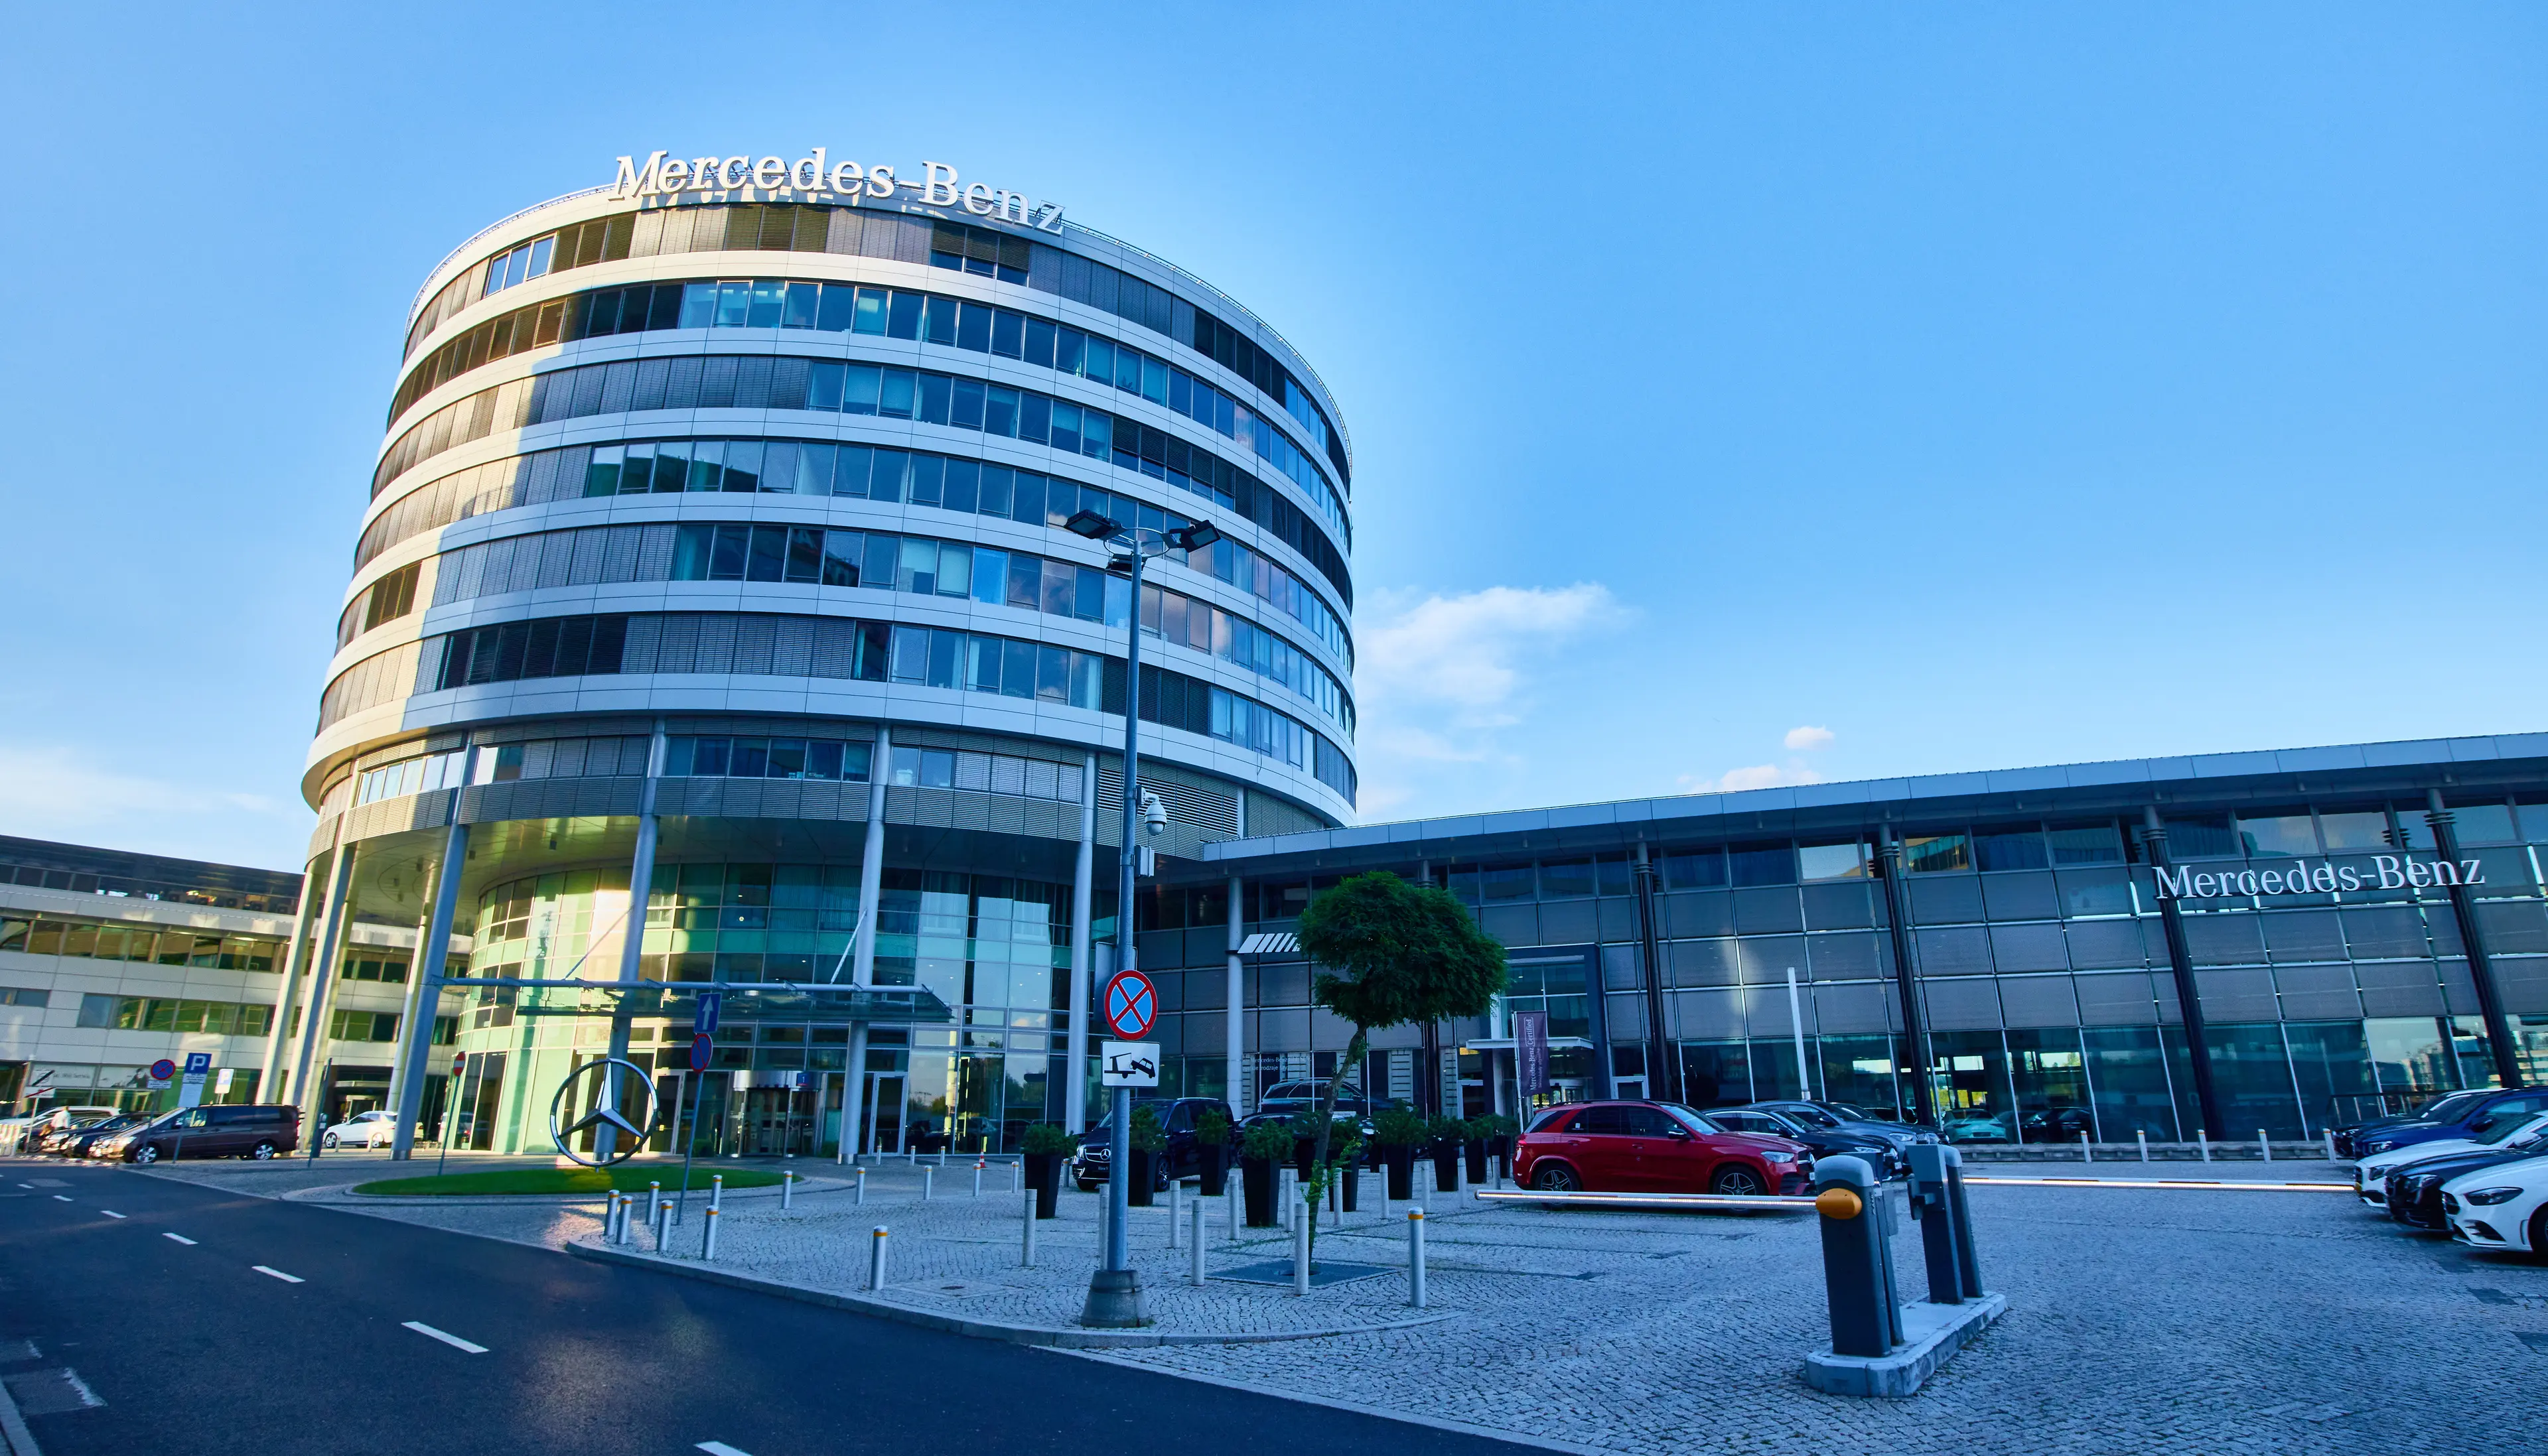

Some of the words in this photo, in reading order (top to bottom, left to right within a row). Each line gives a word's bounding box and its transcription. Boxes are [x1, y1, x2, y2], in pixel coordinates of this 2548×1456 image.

[608, 147, 1066, 236] Mercedes-Benz
[2152, 855, 2485, 899] Mercedes-Benz
[190, 1055, 206, 1071] P
[220, 1071, 230, 1084] P
